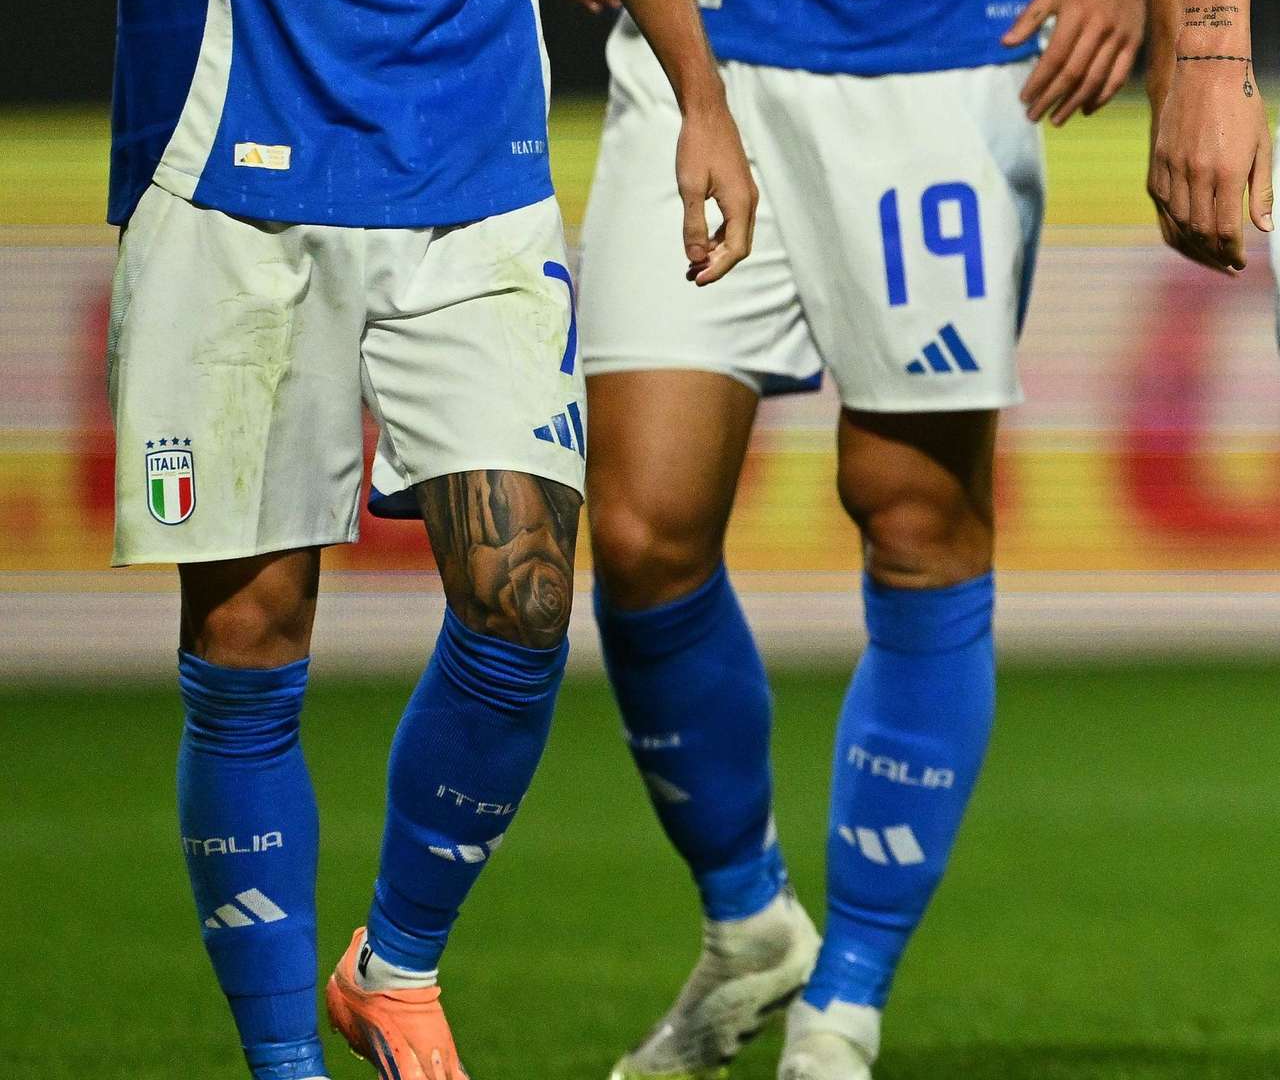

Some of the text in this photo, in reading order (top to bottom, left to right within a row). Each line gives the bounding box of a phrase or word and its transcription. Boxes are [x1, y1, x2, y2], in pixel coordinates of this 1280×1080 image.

[878, 181, 986, 308] 19
[543, 260, 578, 376] 7
[150, 455, 190, 471] ITALIA
[847, 743, 956, 789] ITALIA
[181, 830, 284, 857] ITALIA
